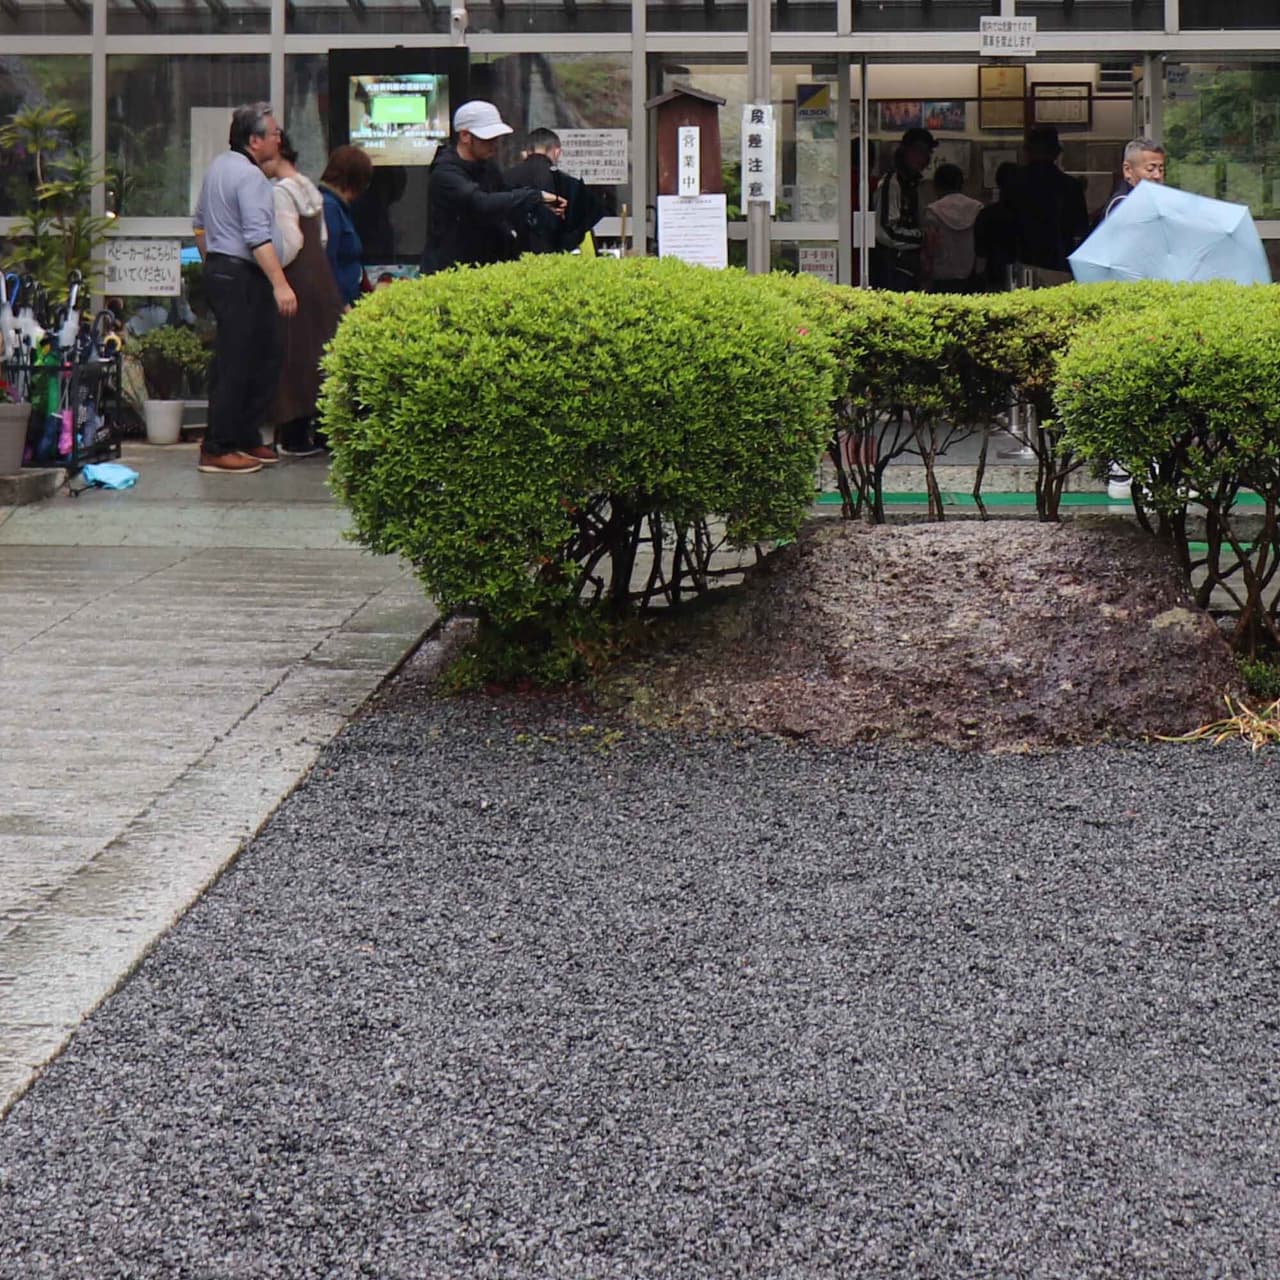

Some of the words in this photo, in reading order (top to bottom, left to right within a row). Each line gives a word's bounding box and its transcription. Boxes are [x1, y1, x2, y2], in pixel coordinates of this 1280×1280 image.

[682, 129, 696, 189] 営業中
[747, 108, 766, 198] 段差注意
